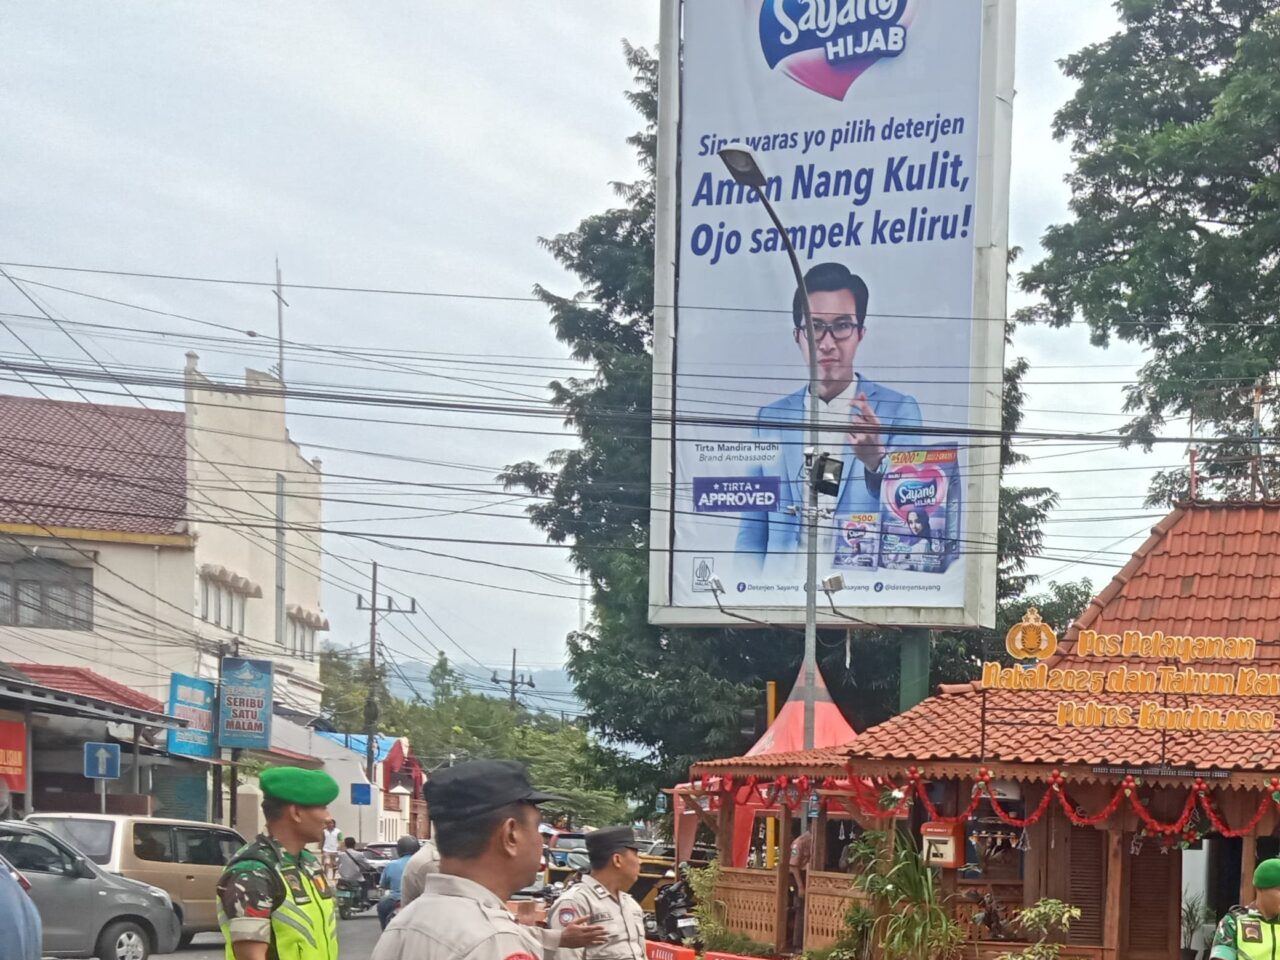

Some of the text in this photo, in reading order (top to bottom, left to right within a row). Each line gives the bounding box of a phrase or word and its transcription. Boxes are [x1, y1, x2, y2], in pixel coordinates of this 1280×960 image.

[775, 0, 899, 45] Sayang
[826, 26, 905, 61] HIJAB
[746, 131, 798, 152] waras
[802, 130, 826, 154] yo
[830, 118, 876, 151] pilih
[881, 113, 965, 145] deterjen
[791, 163, 874, 206] Nang
[883, 151, 970, 193] Kulit,
[690, 204, 973, 265] Ojo sampek keliru!
[695, 443, 715, 452] Tirta
[717, 442, 752, 452] Mandira
[698, 453, 776, 462] Brand Ambassador
[698, 491, 776, 506] APPROVED
[722, 482, 752, 491] TIRTA
[899, 484, 935, 504] Sayang
[1078, 630, 1256, 663] Pos Pelayanan
[981, 661, 1048, 689] Natal
[1048, 668, 1105, 694] 2025
[1106, 665, 1156, 693] dan
[1157, 666, 1234, 694] Tahun
[226, 696, 264, 709] SERIBU
[231, 708, 258, 720] SATU
[225, 720, 263, 732] MALAM
[1057, 700, 1275, 731] Polres Bondowoso
